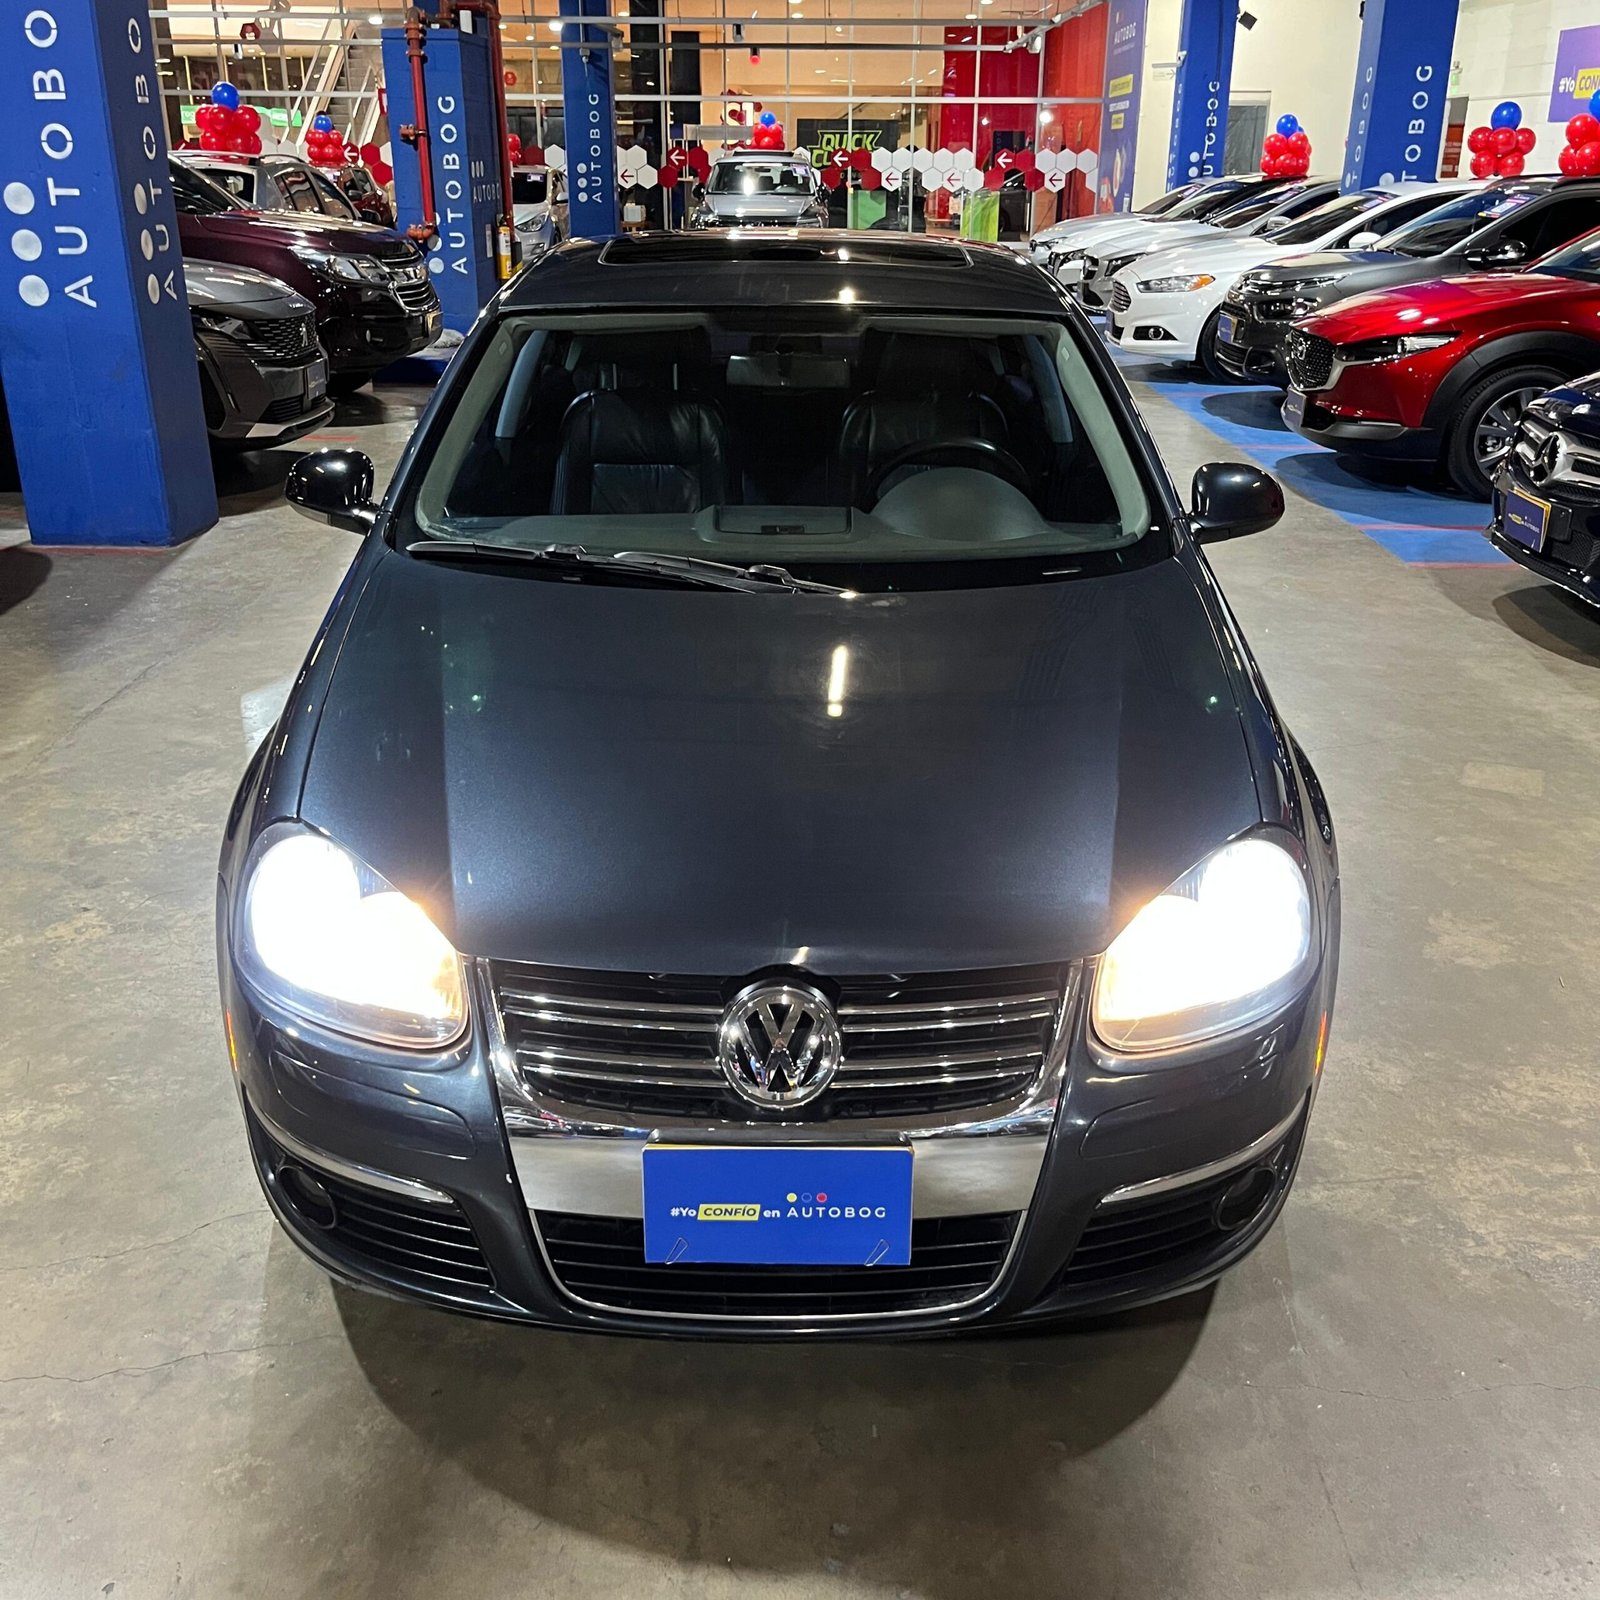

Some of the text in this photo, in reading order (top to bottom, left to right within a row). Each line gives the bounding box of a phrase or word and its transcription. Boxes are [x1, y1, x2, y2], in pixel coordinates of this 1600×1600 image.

[24, 9, 97, 309] AUTOBO
[128, 17, 178, 301] AUTOBO
[586, 93, 603, 204] AUTOBOG
[821, 133, 876, 152] QUICK
[1401, 65, 1433, 183] TOBOG
[437, 95, 468, 275] AUTOBOG
[670, 1205, 886, 1219] #Yo CONFÍO en AUTOBOG
